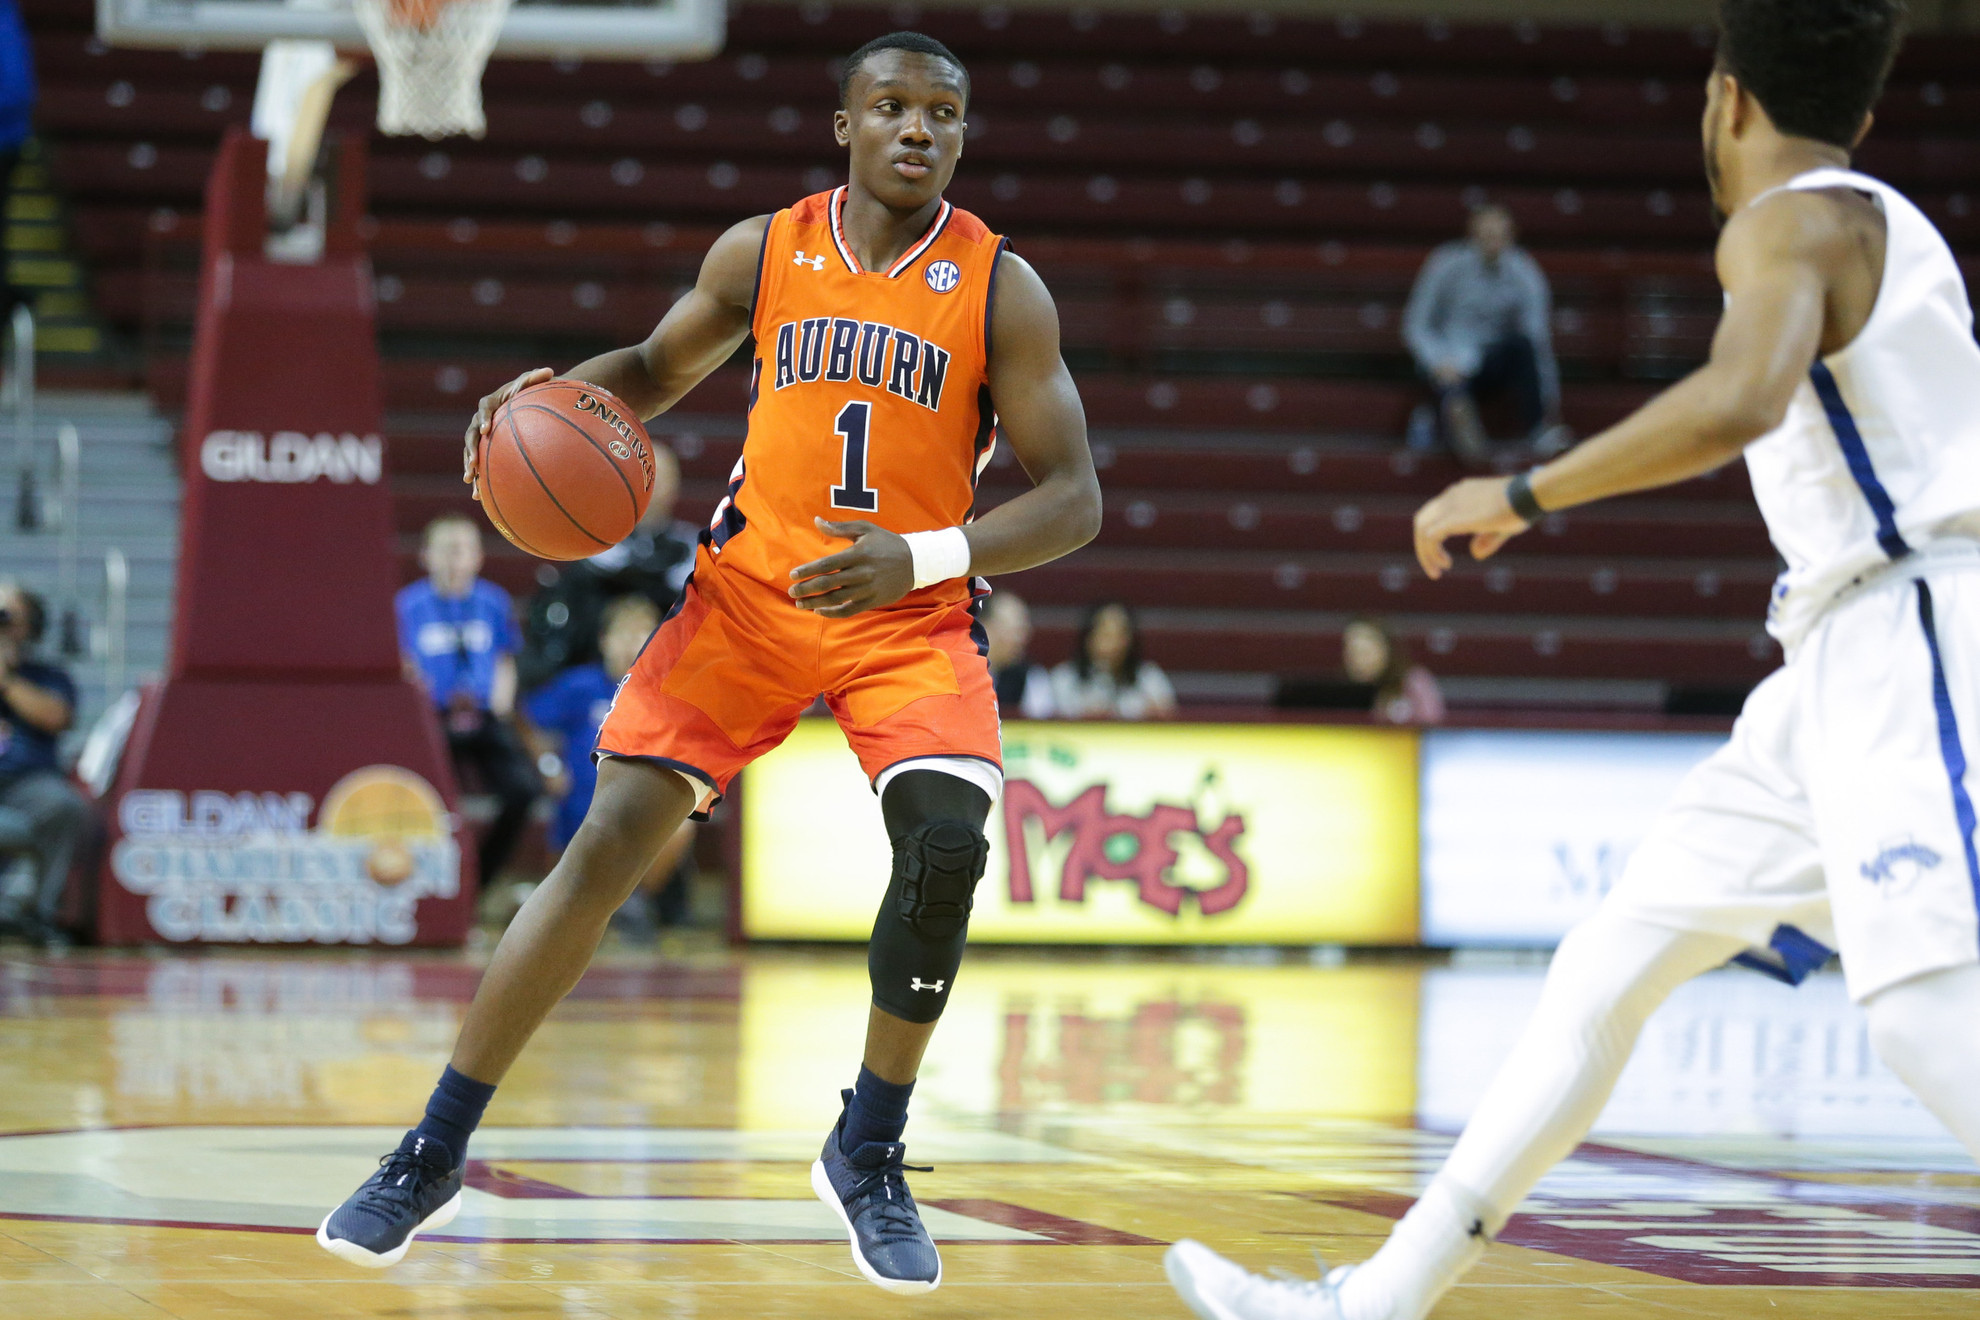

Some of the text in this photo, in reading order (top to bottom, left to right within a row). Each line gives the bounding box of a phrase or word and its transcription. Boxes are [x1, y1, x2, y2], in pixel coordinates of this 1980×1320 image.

[926, 260, 960, 291] SEC
[774, 317, 951, 412] AUBURN
[201, 429, 383, 486] GILDAN
[573, 392, 656, 493] SPALDING
[830, 400, 879, 513] 1
